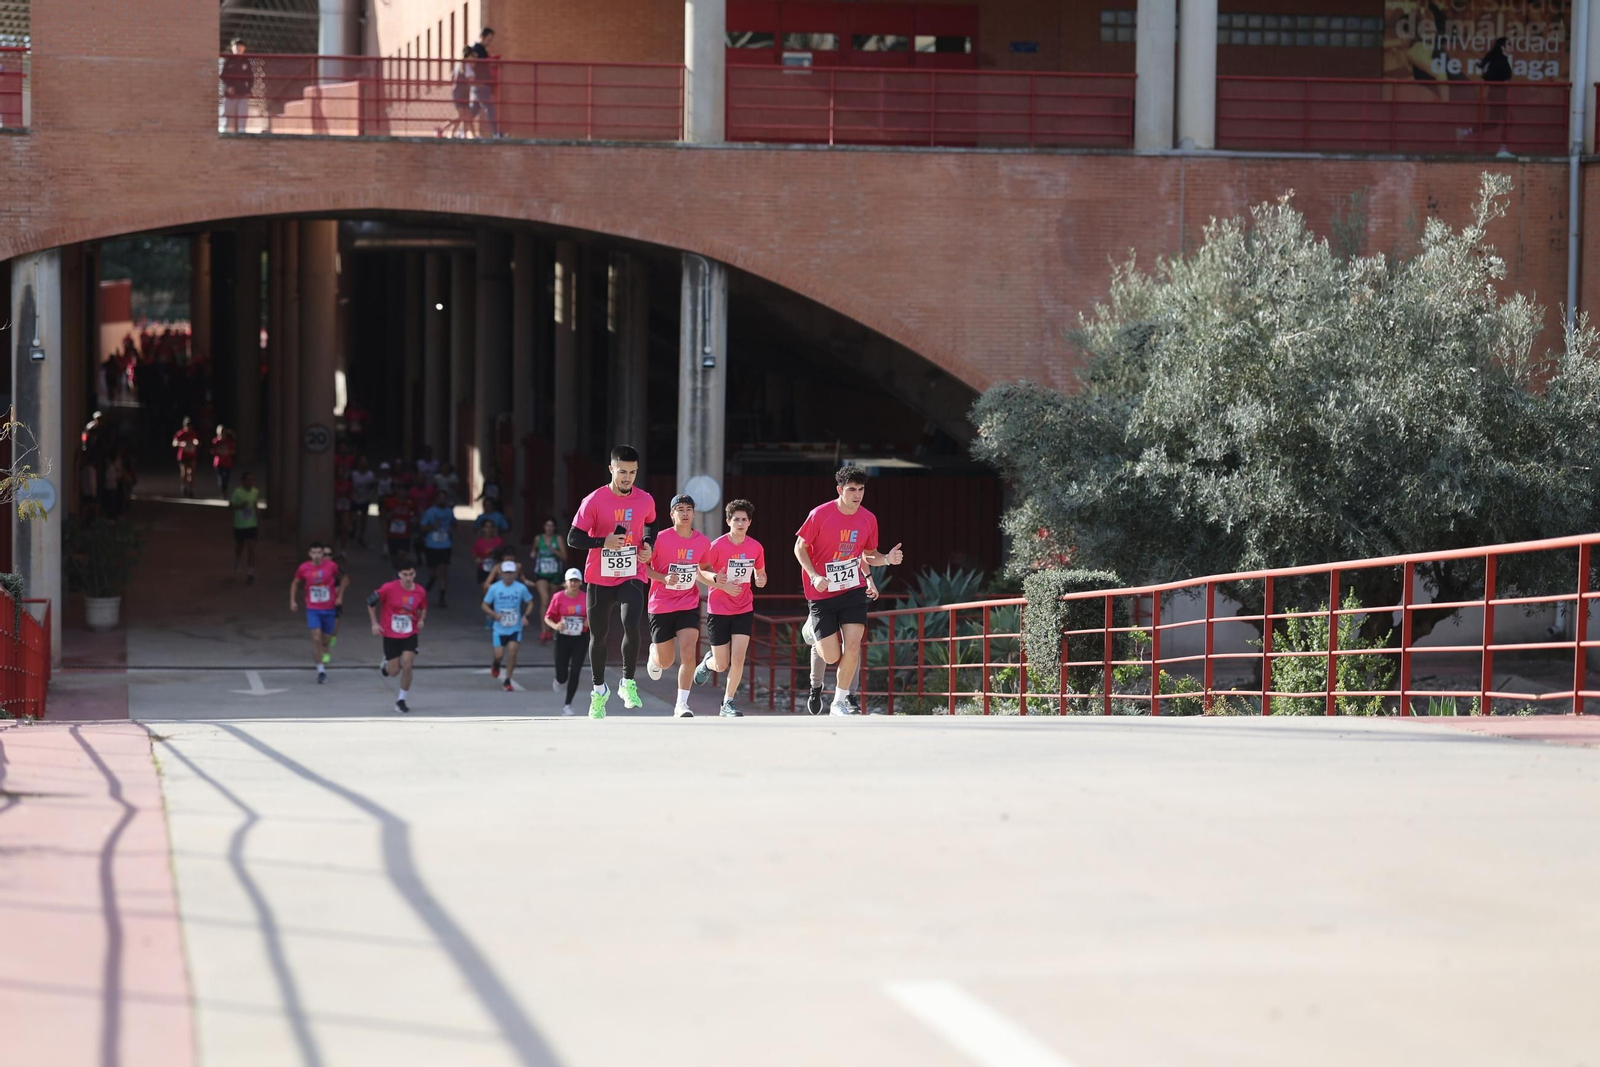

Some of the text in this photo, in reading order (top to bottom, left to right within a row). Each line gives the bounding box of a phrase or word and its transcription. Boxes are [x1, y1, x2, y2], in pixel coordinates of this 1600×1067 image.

[1396, 9, 1437, 39] de
[1431, 53, 1462, 75] de
[308, 432, 326, 444] 20
[614, 508, 633, 521] WE
[840, 529, 858, 543] WE
[677, 549, 693, 560] WE
[608, 557, 632, 568] 585
[676, 573, 693, 583] 38
[734, 567, 747, 577] 59
[833, 569, 854, 583] 124
